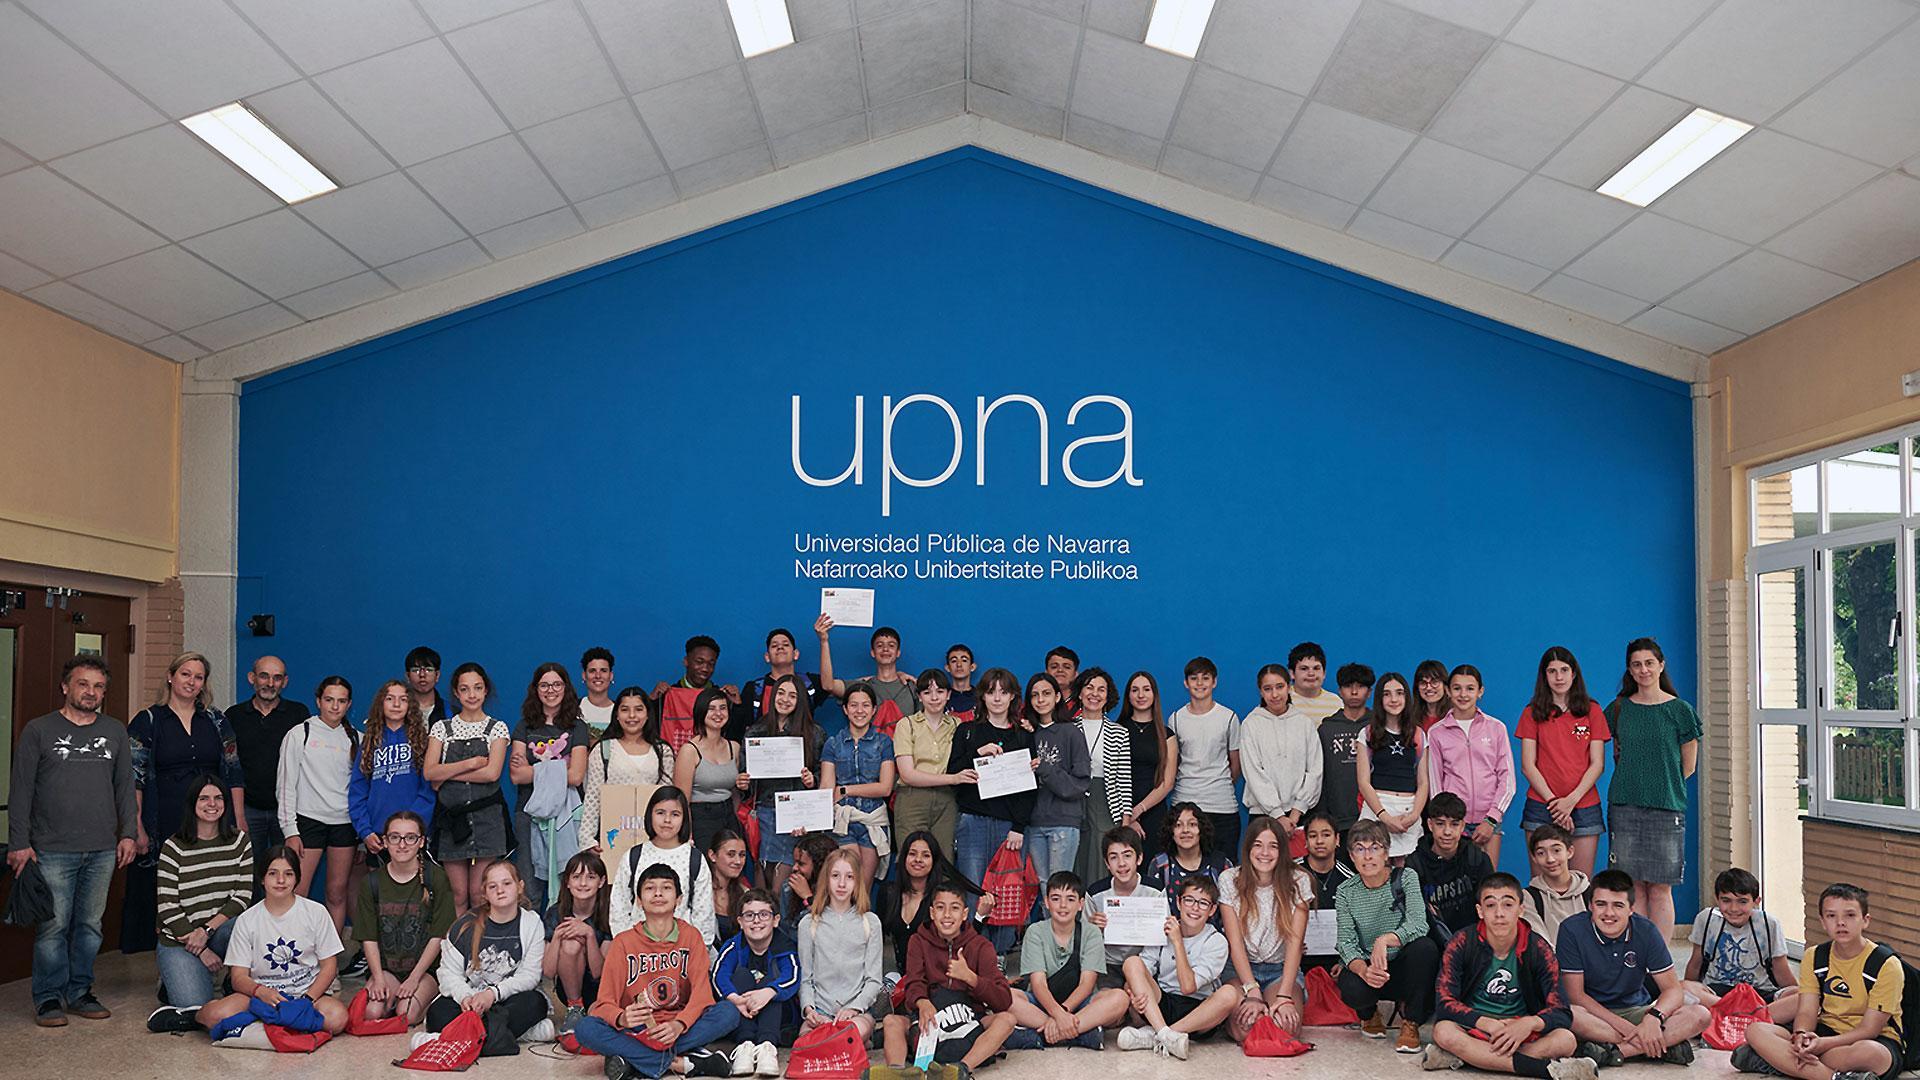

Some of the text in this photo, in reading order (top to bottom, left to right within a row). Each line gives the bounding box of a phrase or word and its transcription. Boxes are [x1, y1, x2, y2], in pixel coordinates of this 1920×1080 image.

[791, 393, 1144, 517] upna
[795, 533, 1131, 555] Universidad Pública de Navarra
[795, 559, 1139, 580] Nafarroako Unibertsitate Publikoa
[626, 948, 690, 987] DETROT
[657, 982, 668, 1001] 9
